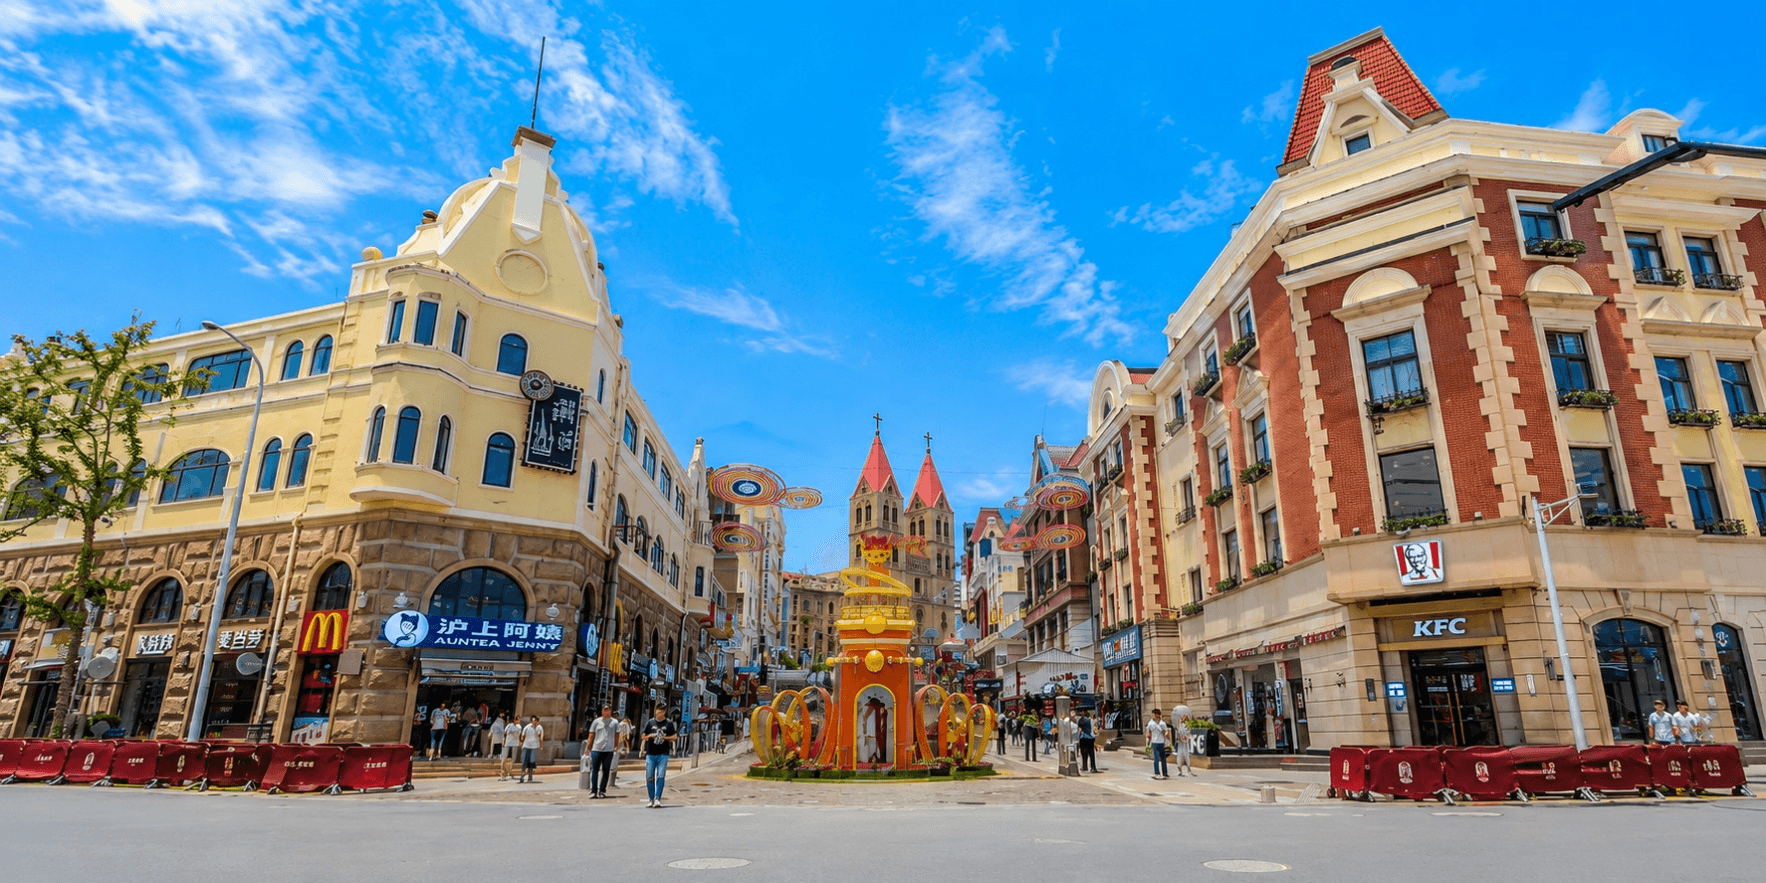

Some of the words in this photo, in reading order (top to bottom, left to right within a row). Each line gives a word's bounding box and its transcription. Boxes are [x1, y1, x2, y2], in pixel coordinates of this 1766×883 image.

[1413, 617, 1466, 637] KFC
[434, 636, 500, 648] AUNTEA
[506, 640, 561, 650] JENNY
